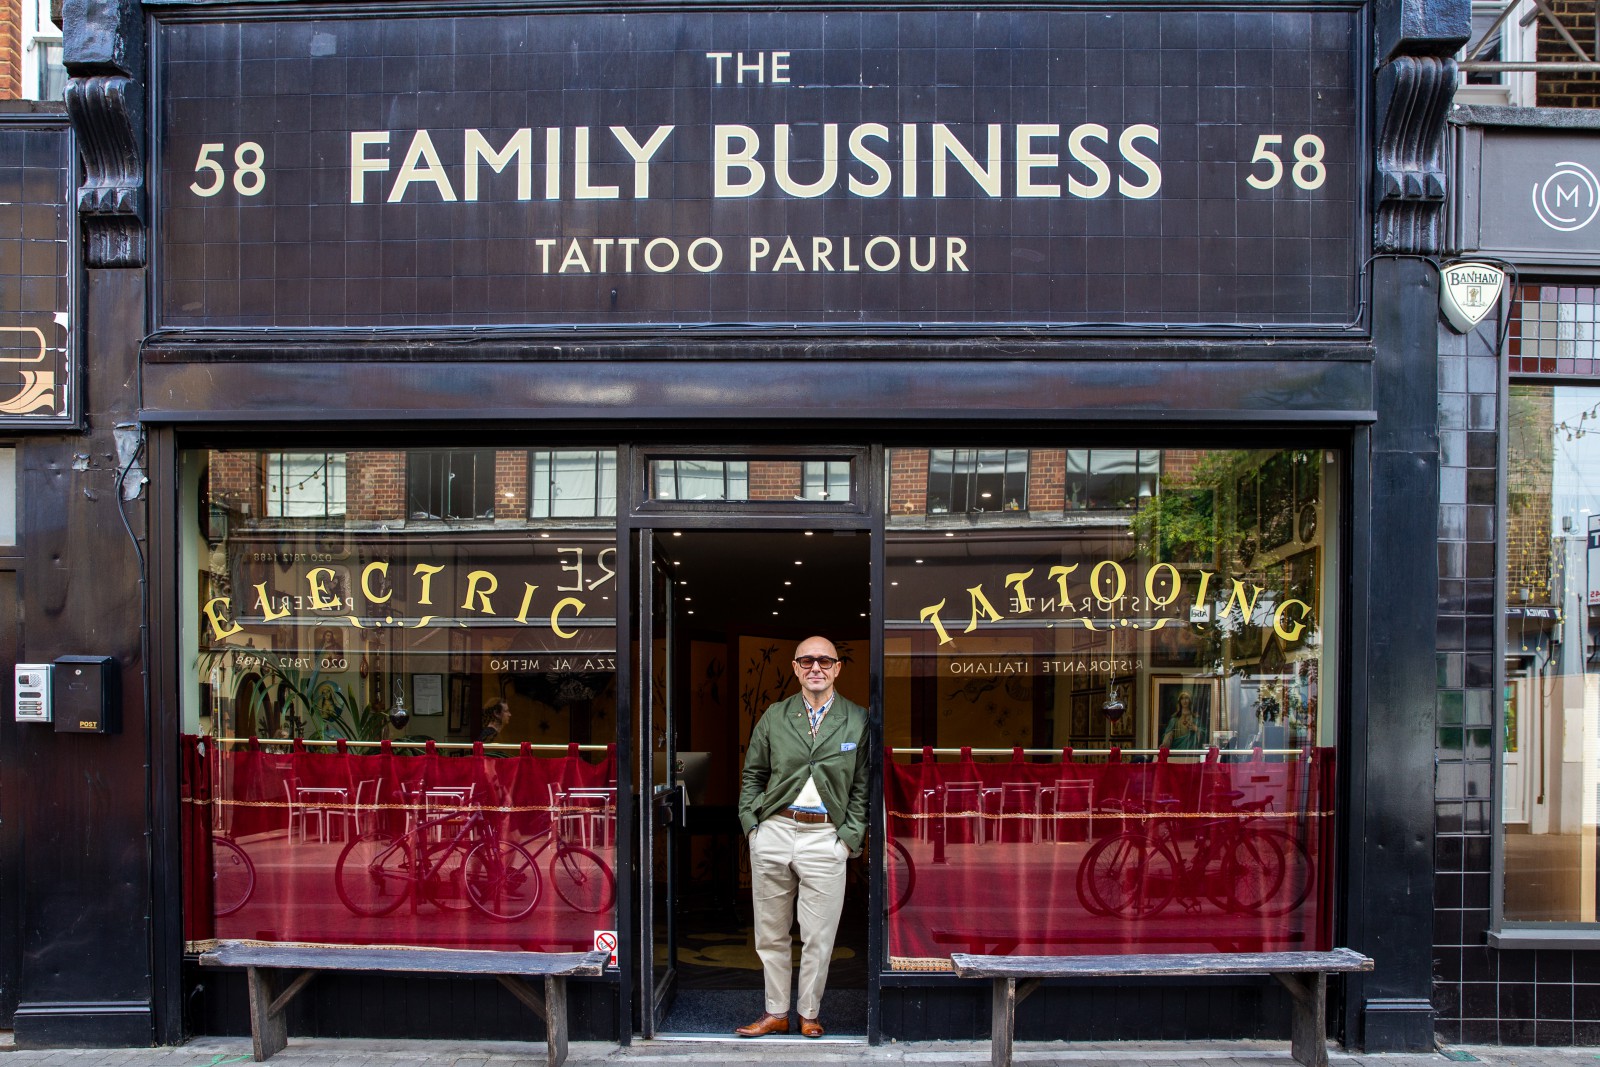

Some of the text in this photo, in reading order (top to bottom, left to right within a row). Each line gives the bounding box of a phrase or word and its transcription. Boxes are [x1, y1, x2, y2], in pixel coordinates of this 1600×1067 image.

[706, 51, 791, 84] THE
[189, 141, 266, 197] 58
[350, 122, 1162, 203] FAMILY BUSINESS
[1246, 134, 1327, 190] 58
[1556, 184, 1579, 208] M
[535, 235, 969, 274] TATTOO PARLOUR
[1450, 272, 1498, 285] BANHAM
[202, 561, 587, 642] ELECTRIC
[919, 560, 1313, 647] TATTOOING
